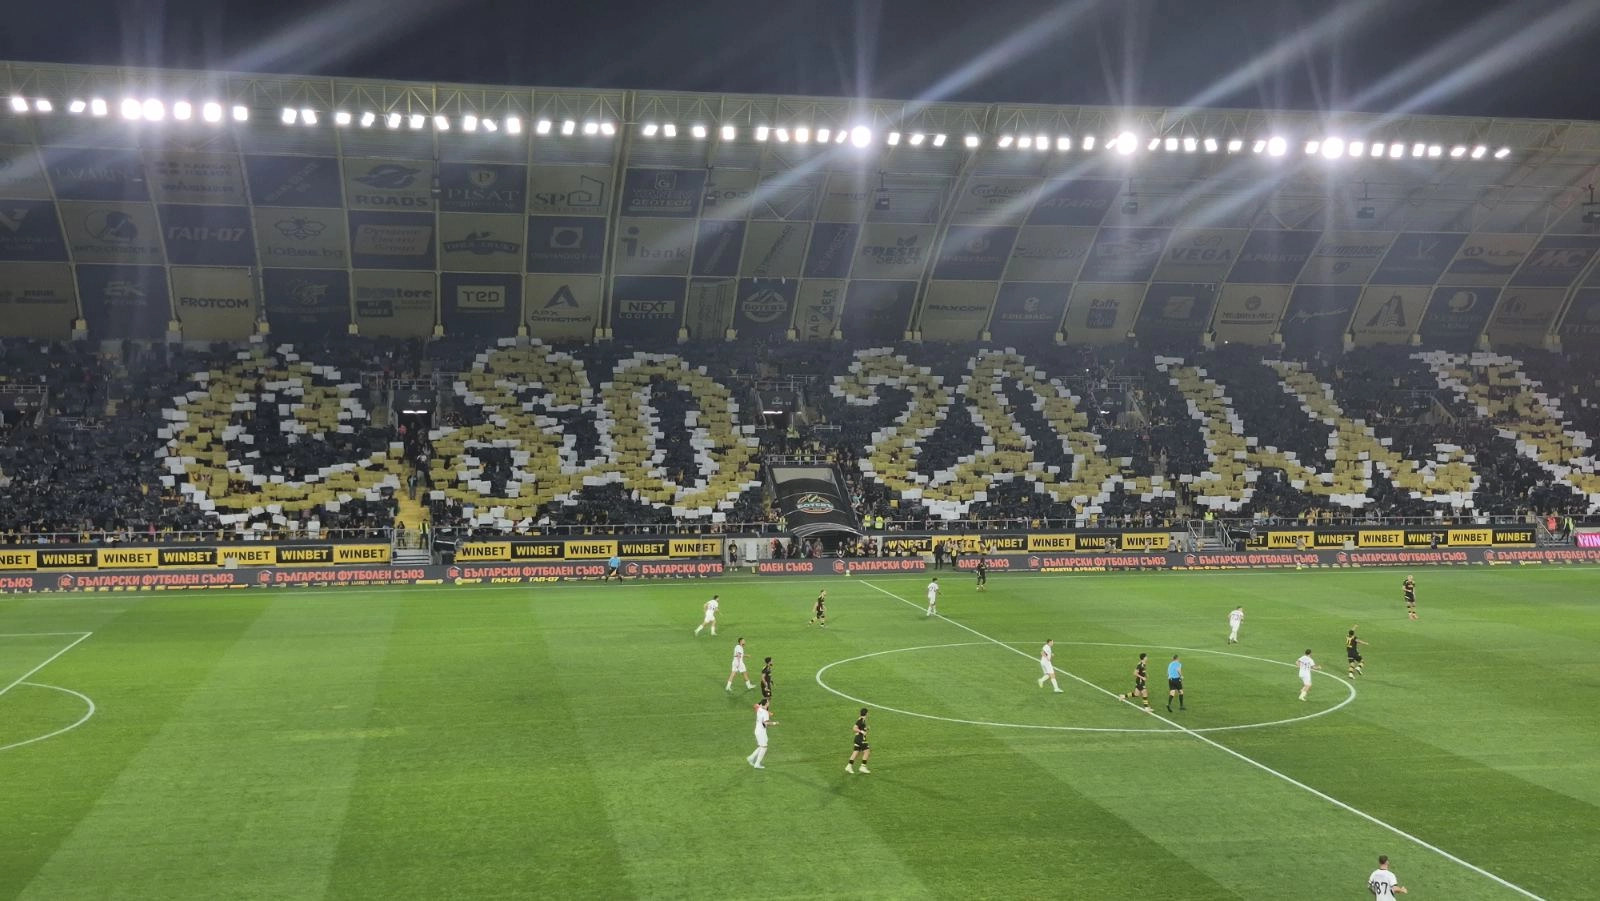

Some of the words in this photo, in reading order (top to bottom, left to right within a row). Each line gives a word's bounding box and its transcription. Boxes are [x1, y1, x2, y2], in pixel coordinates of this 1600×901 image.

[446, 188, 521, 201] PISAT
[354, 195, 430, 207] ROADS
[1171, 247, 1233, 261] VEGA
[180, 297, 249, 309] FROTCOM
[629, 301, 666, 313] NEXT
[1032, 537, 1071, 547] WINBET
[1246, 535, 1264, 545] BET
[1273, 535, 1309, 544] WINBT
[1363, 534, 1399, 543] WINBET
[1408, 533, 1444, 542] WINBT
[1452, 532, 1488, 542] WINBET
[1496, 532, 1532, 542] WINBET
[1578, 534, 1600, 546] WIN
[570, 544, 612, 555] WINBET
[622, 543, 665, 554] WINBET
[674, 542, 716, 553] WINBET
[888, 540, 928, 549] WNBET
[223, 550, 271, 562] WINBET
[281, 549, 329, 561] WINBET
[339, 548, 386, 559] WINBET
[461, 546, 506, 557] WINBET
[516, 545, 559, 556] WINBET
[1498, 551, 1543, 561] БЪЛГАРСКИ
[1545, 550, 1587, 560] ФУТБОЛЕН
[1588, 550, 1600, 559] СЪ
[42, 553, 92, 565] WINBET
[103, 553, 152, 563] WINBET
[163, 551, 213, 563] WINBET
[1043, 557, 1092, 567] БЪЛГАРСКИ
[1094, 557, 1139, 566] ФУТБОЛЕН
[1141, 556, 1166, 565] СЪЮЗ
[1198, 555, 1247, 564] БЪЛГАРСКИ
[1248, 555, 1292, 564] ФУТБОЛЕН
[1293, 554, 1319, 563] СЪЮЗ
[1351, 552, 1397, 562] БЪЛГАРСКИ
[1398, 552, 1441, 561] ФУТБОЛЕН
[1442, 551, 1467, 561] СЪЮЗ
[642, 563, 695, 574] БЪЛГАРСКИ
[697, 562, 723, 573] ФУТБ
[759, 563, 786, 572] ОЛЕН
[788, 562, 814, 572] СЪЮЗ
[848, 561, 899, 571] БЪЛГАРСКИ
[901, 560, 925, 570] ФУТБ
[984, 558, 1009, 568] СЪЮЗ
[275, 571, 335, 582] БЪЛГАРСКИ
[337, 570, 391, 581] ФУТБОЛЕН
[393, 569, 425, 580] СЪЮЗ
[464, 567, 520, 577] БЪЛГАРСКИ
[522, 566, 574, 576] ФУТБОЛЕН
[575, 565, 605, 575] СЪЮЗ
[77, 574, 139, 587] БЪЛГАРСКИ
[141, 573, 199, 586] ФУТБОЛЕН
[201, 573, 234, 584] СЪЮЗ
[1373, 881, 1388, 895] 87
